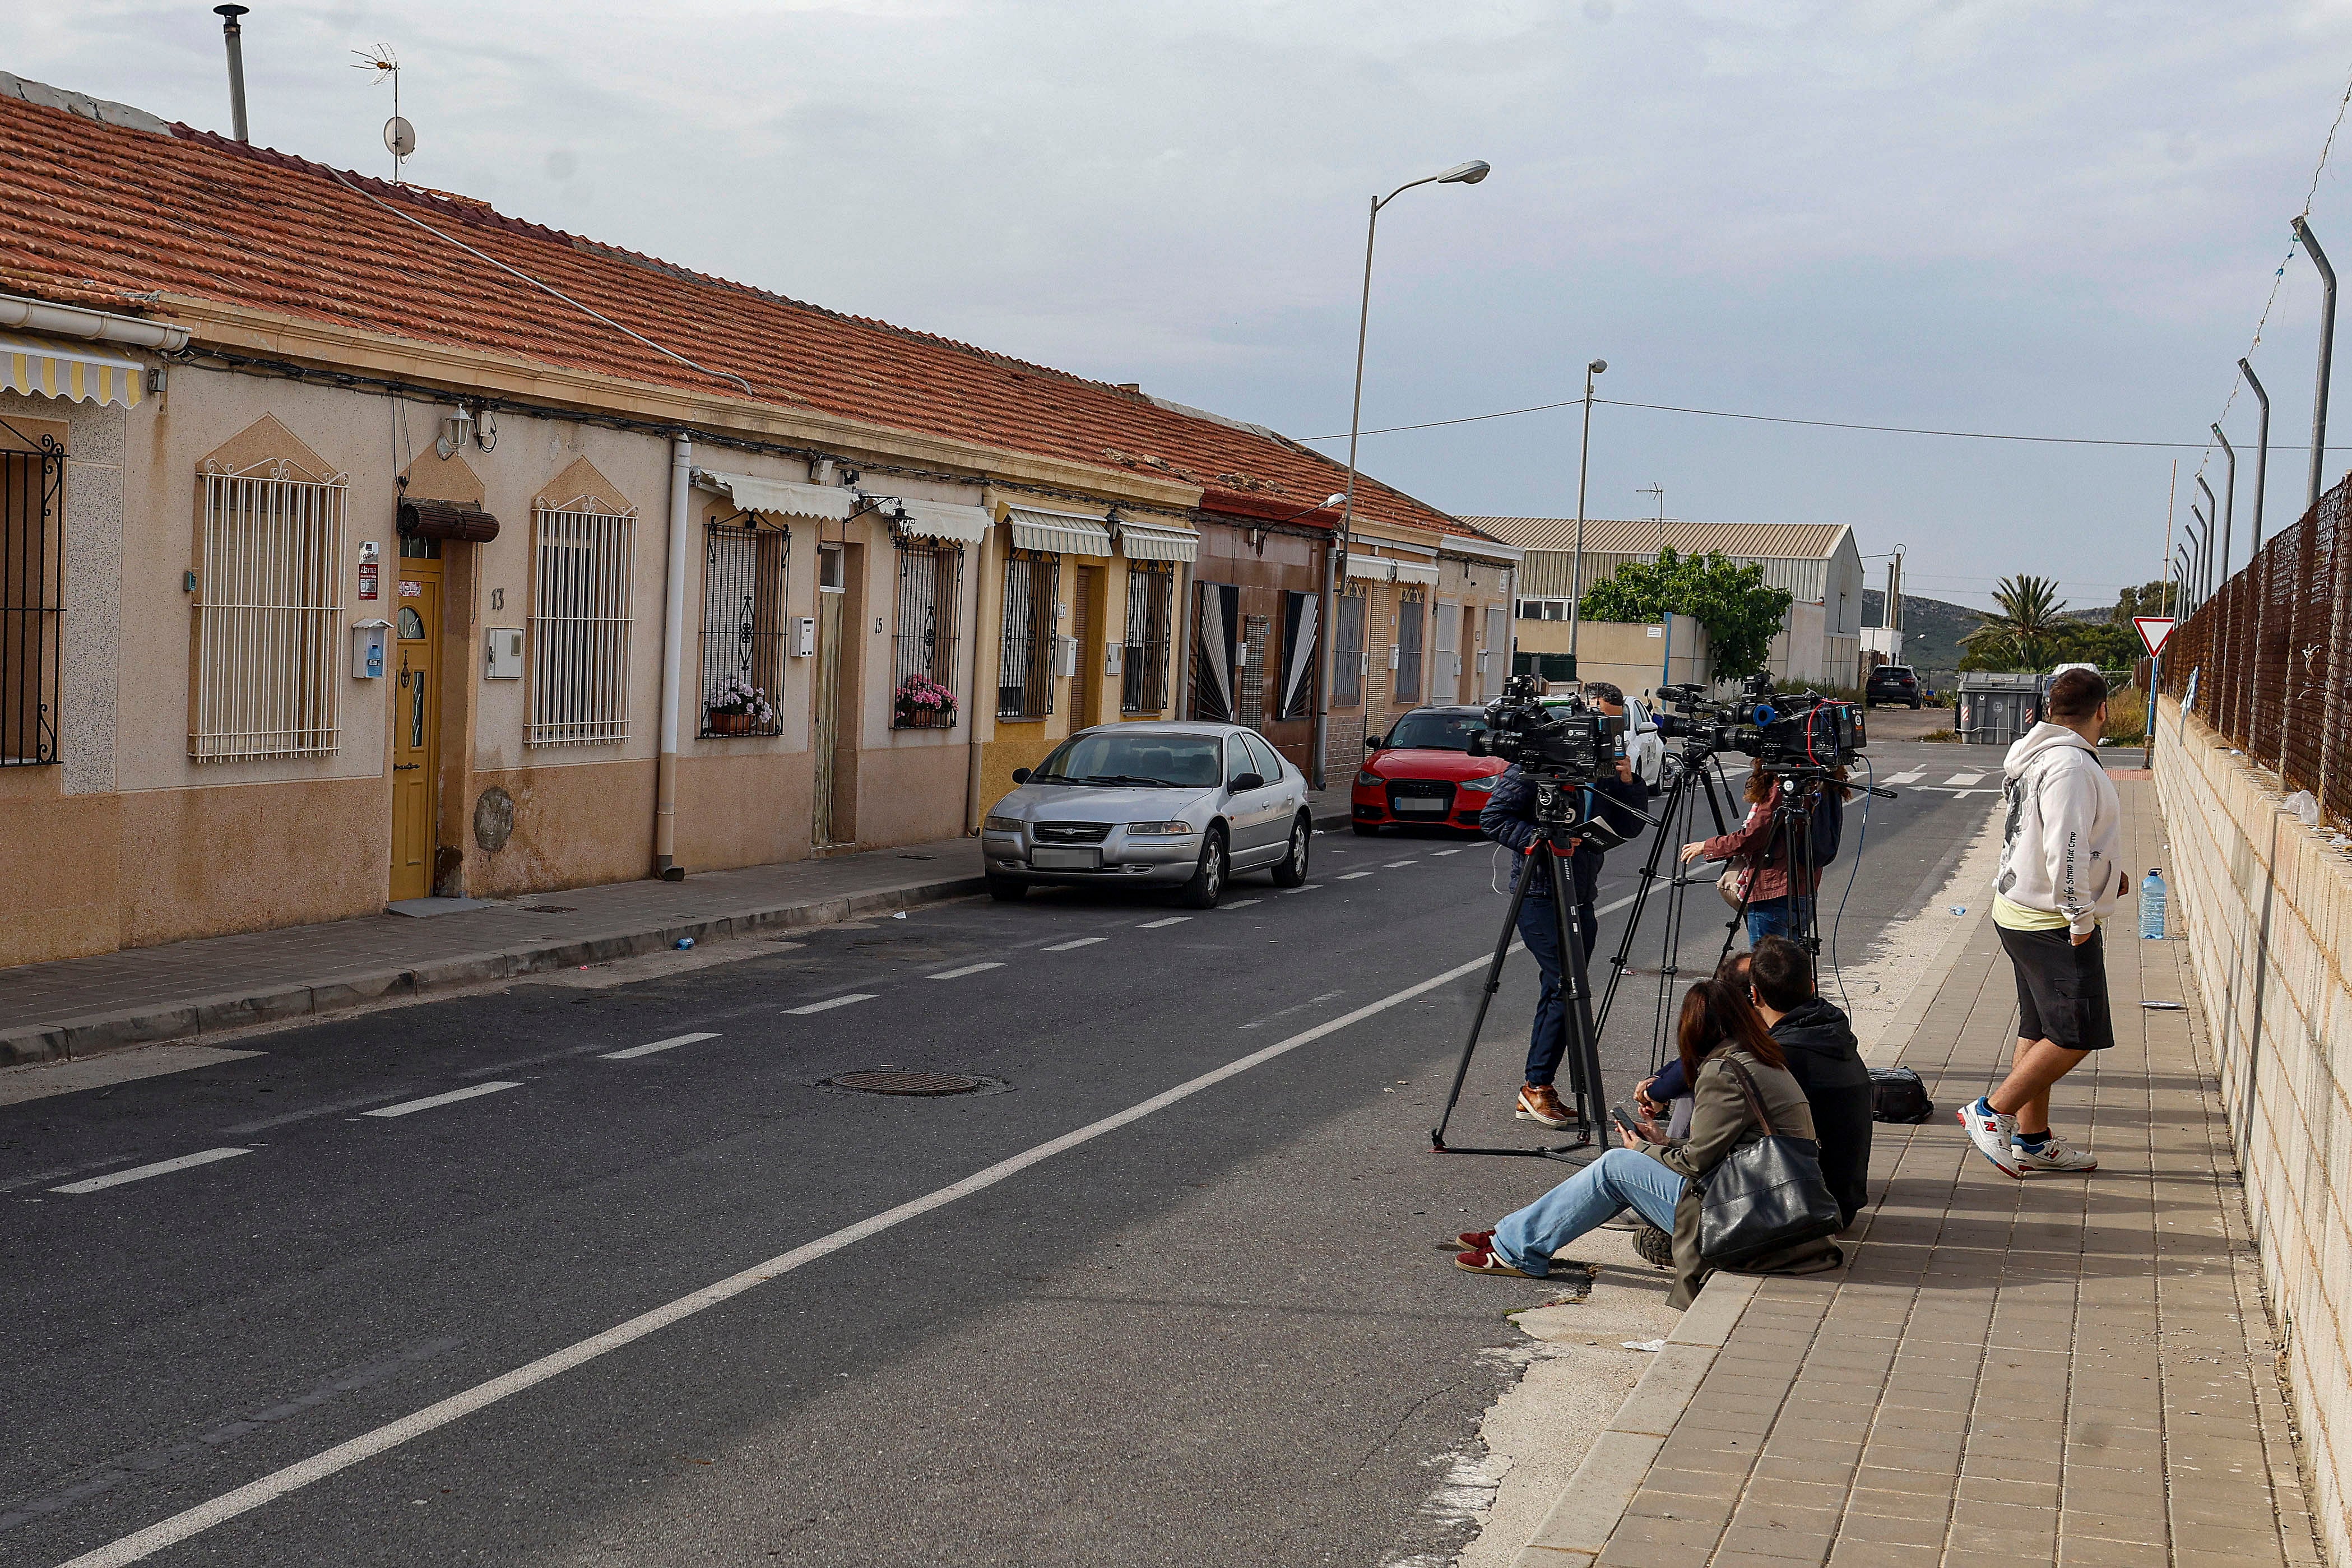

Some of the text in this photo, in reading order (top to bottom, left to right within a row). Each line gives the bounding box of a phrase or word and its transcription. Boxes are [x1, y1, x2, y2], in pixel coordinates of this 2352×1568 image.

[360, 565, 376, 574] Alarma
[491, 588, 504, 610] 13
[1060, 605, 1065, 615] 17
[875, 617, 882, 634] 15
[2068, 831, 2076, 848] Crew
[2066, 864, 2074, 884] Straw
